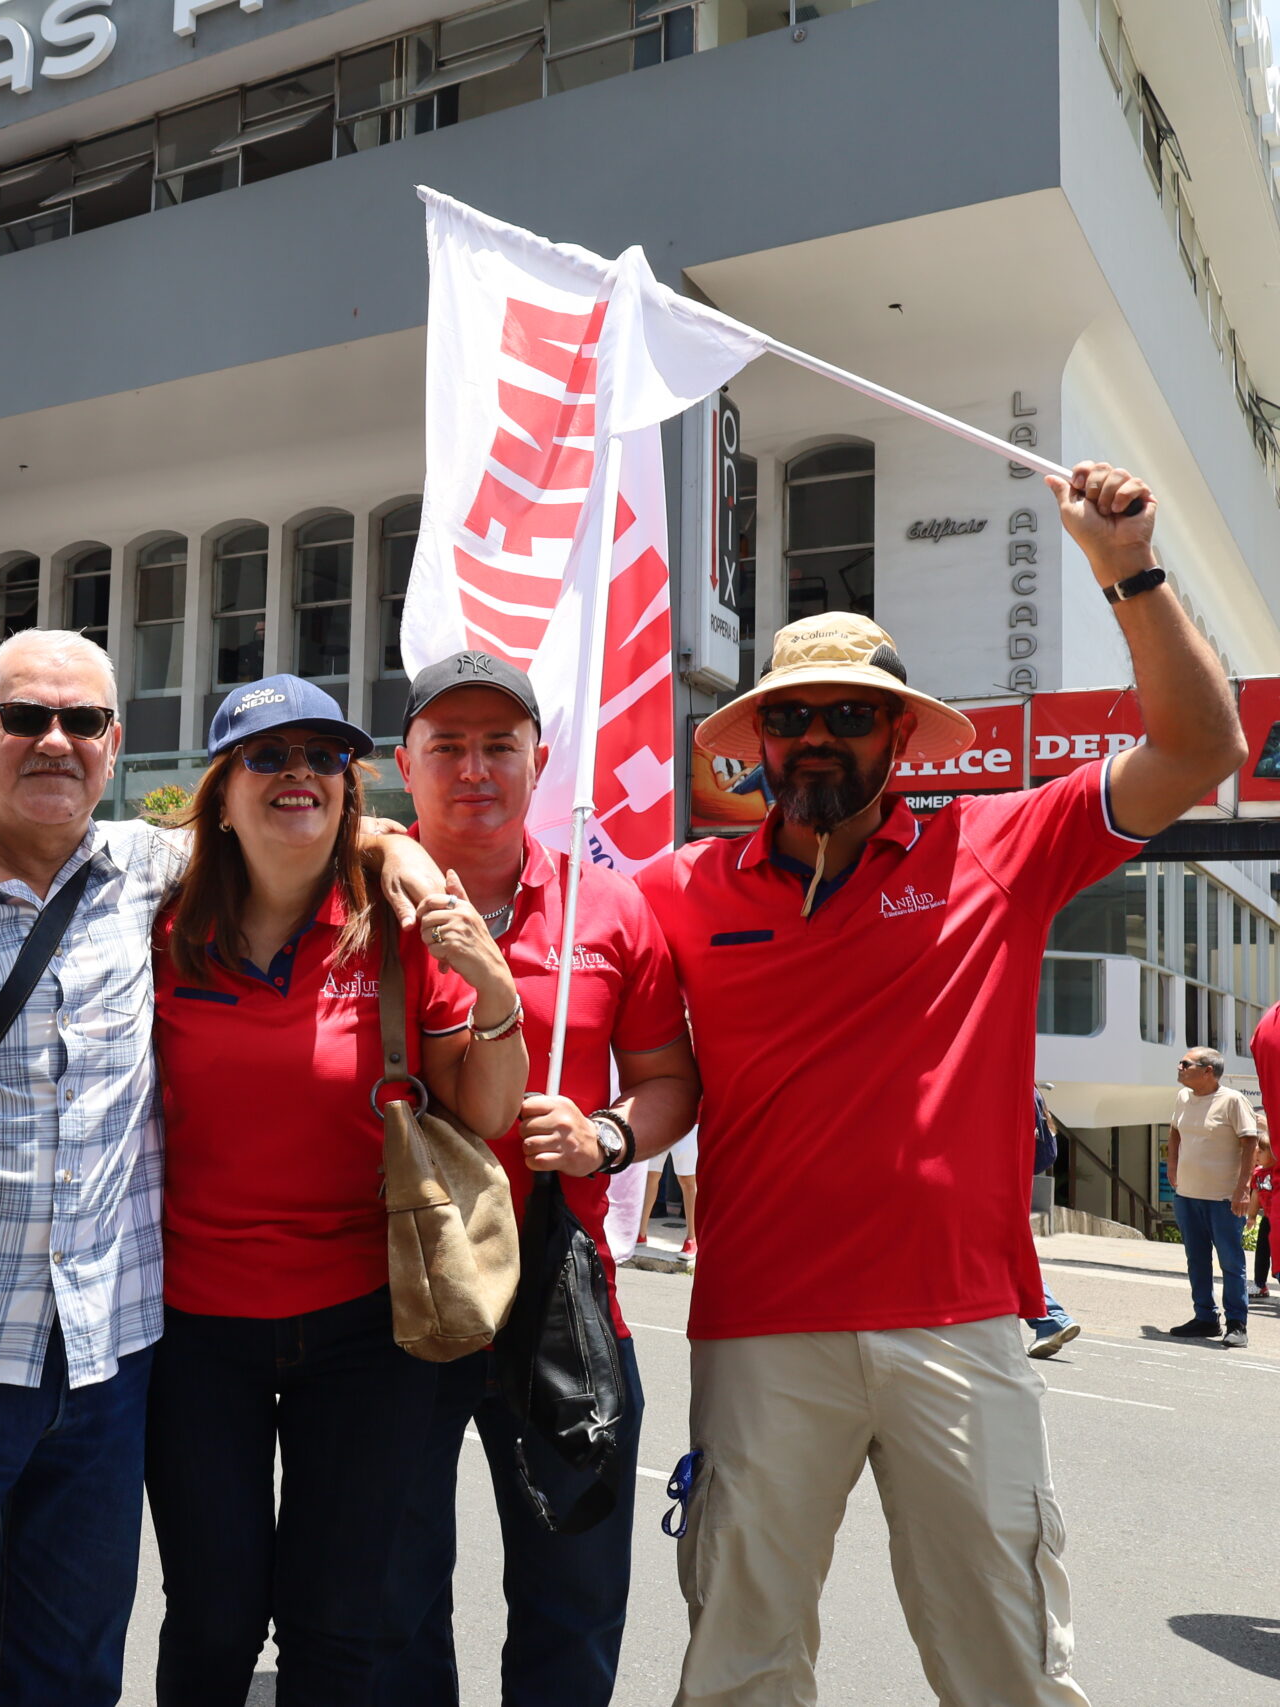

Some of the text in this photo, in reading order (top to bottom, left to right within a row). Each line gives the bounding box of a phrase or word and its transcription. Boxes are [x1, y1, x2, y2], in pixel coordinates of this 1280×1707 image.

[906, 517, 988, 543] Edificio
[233, 693, 286, 717] ANEJUD
[1035, 733, 1147, 760] DEP
